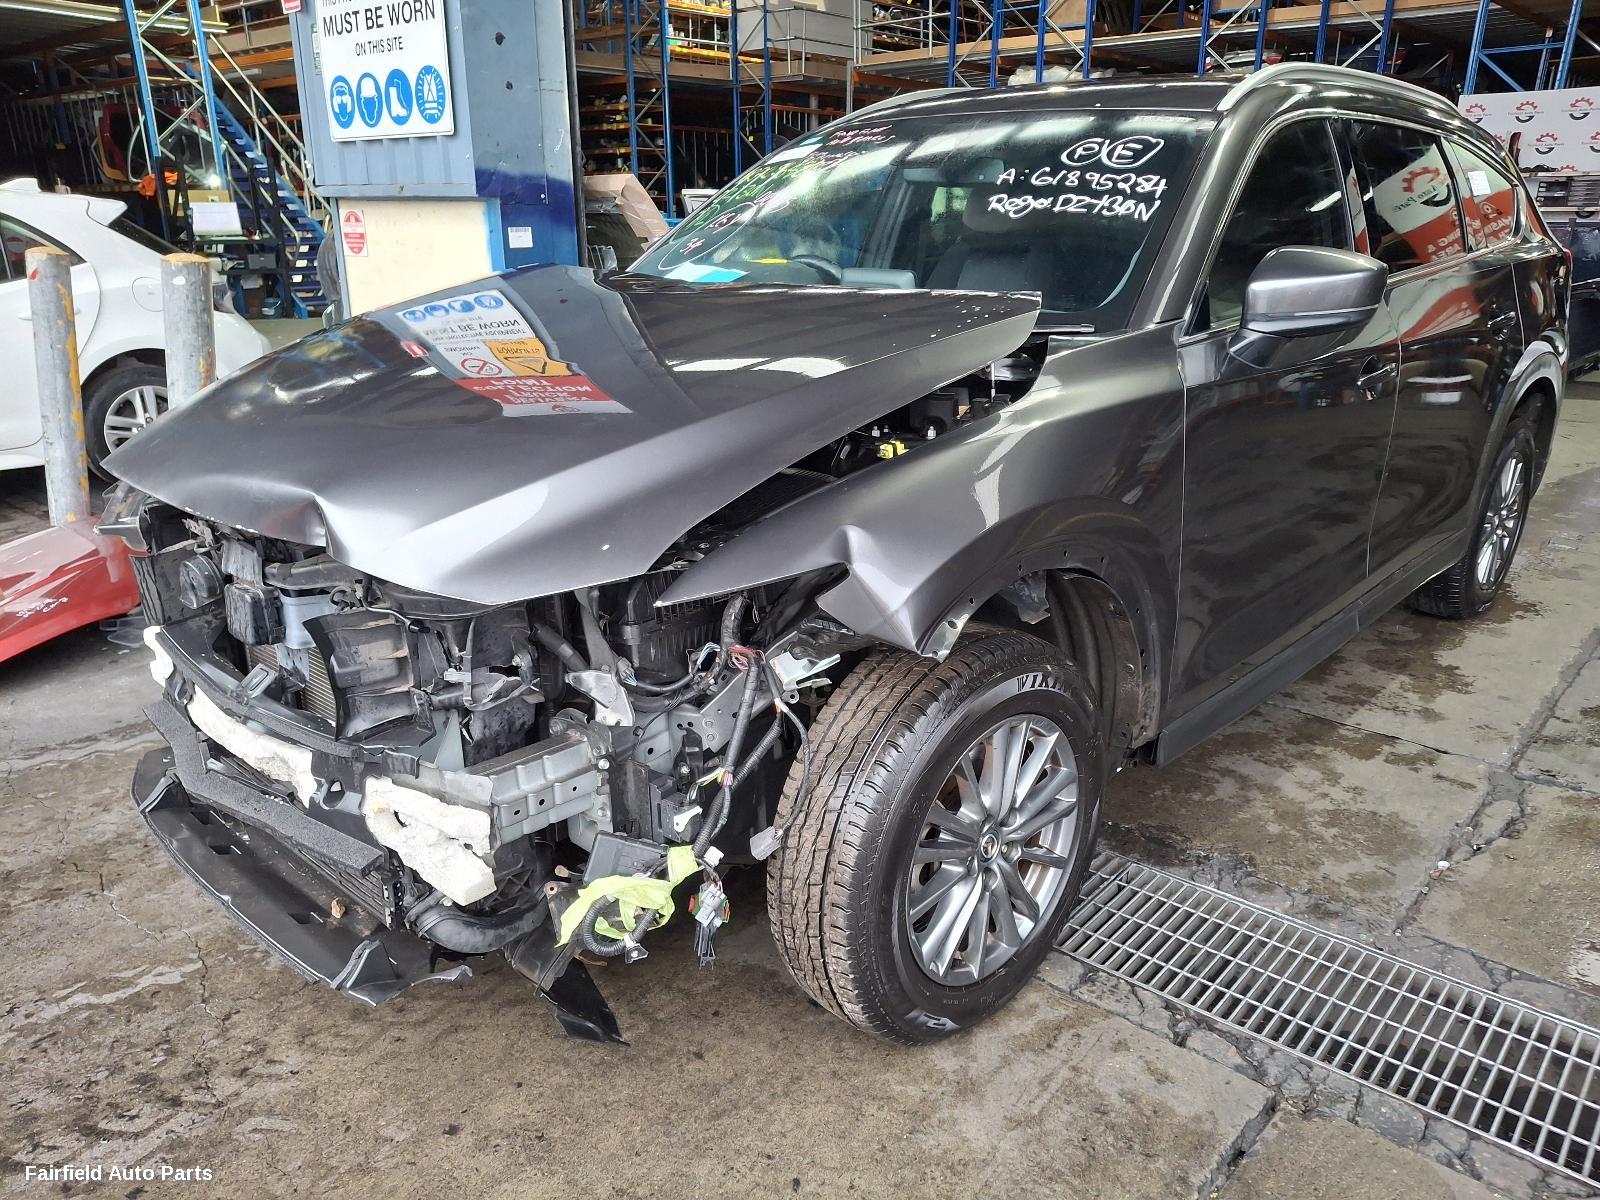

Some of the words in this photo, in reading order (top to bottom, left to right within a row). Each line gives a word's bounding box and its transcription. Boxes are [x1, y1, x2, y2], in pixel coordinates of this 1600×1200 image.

[322, 10, 360, 37] MUST
[364, 6, 384, 31] BE
[386, 0, 435, 26] WORN
[355, 42, 366, 56] ON
[367, 39, 385, 55] THIS
[386, 36, 403, 52] SITE
